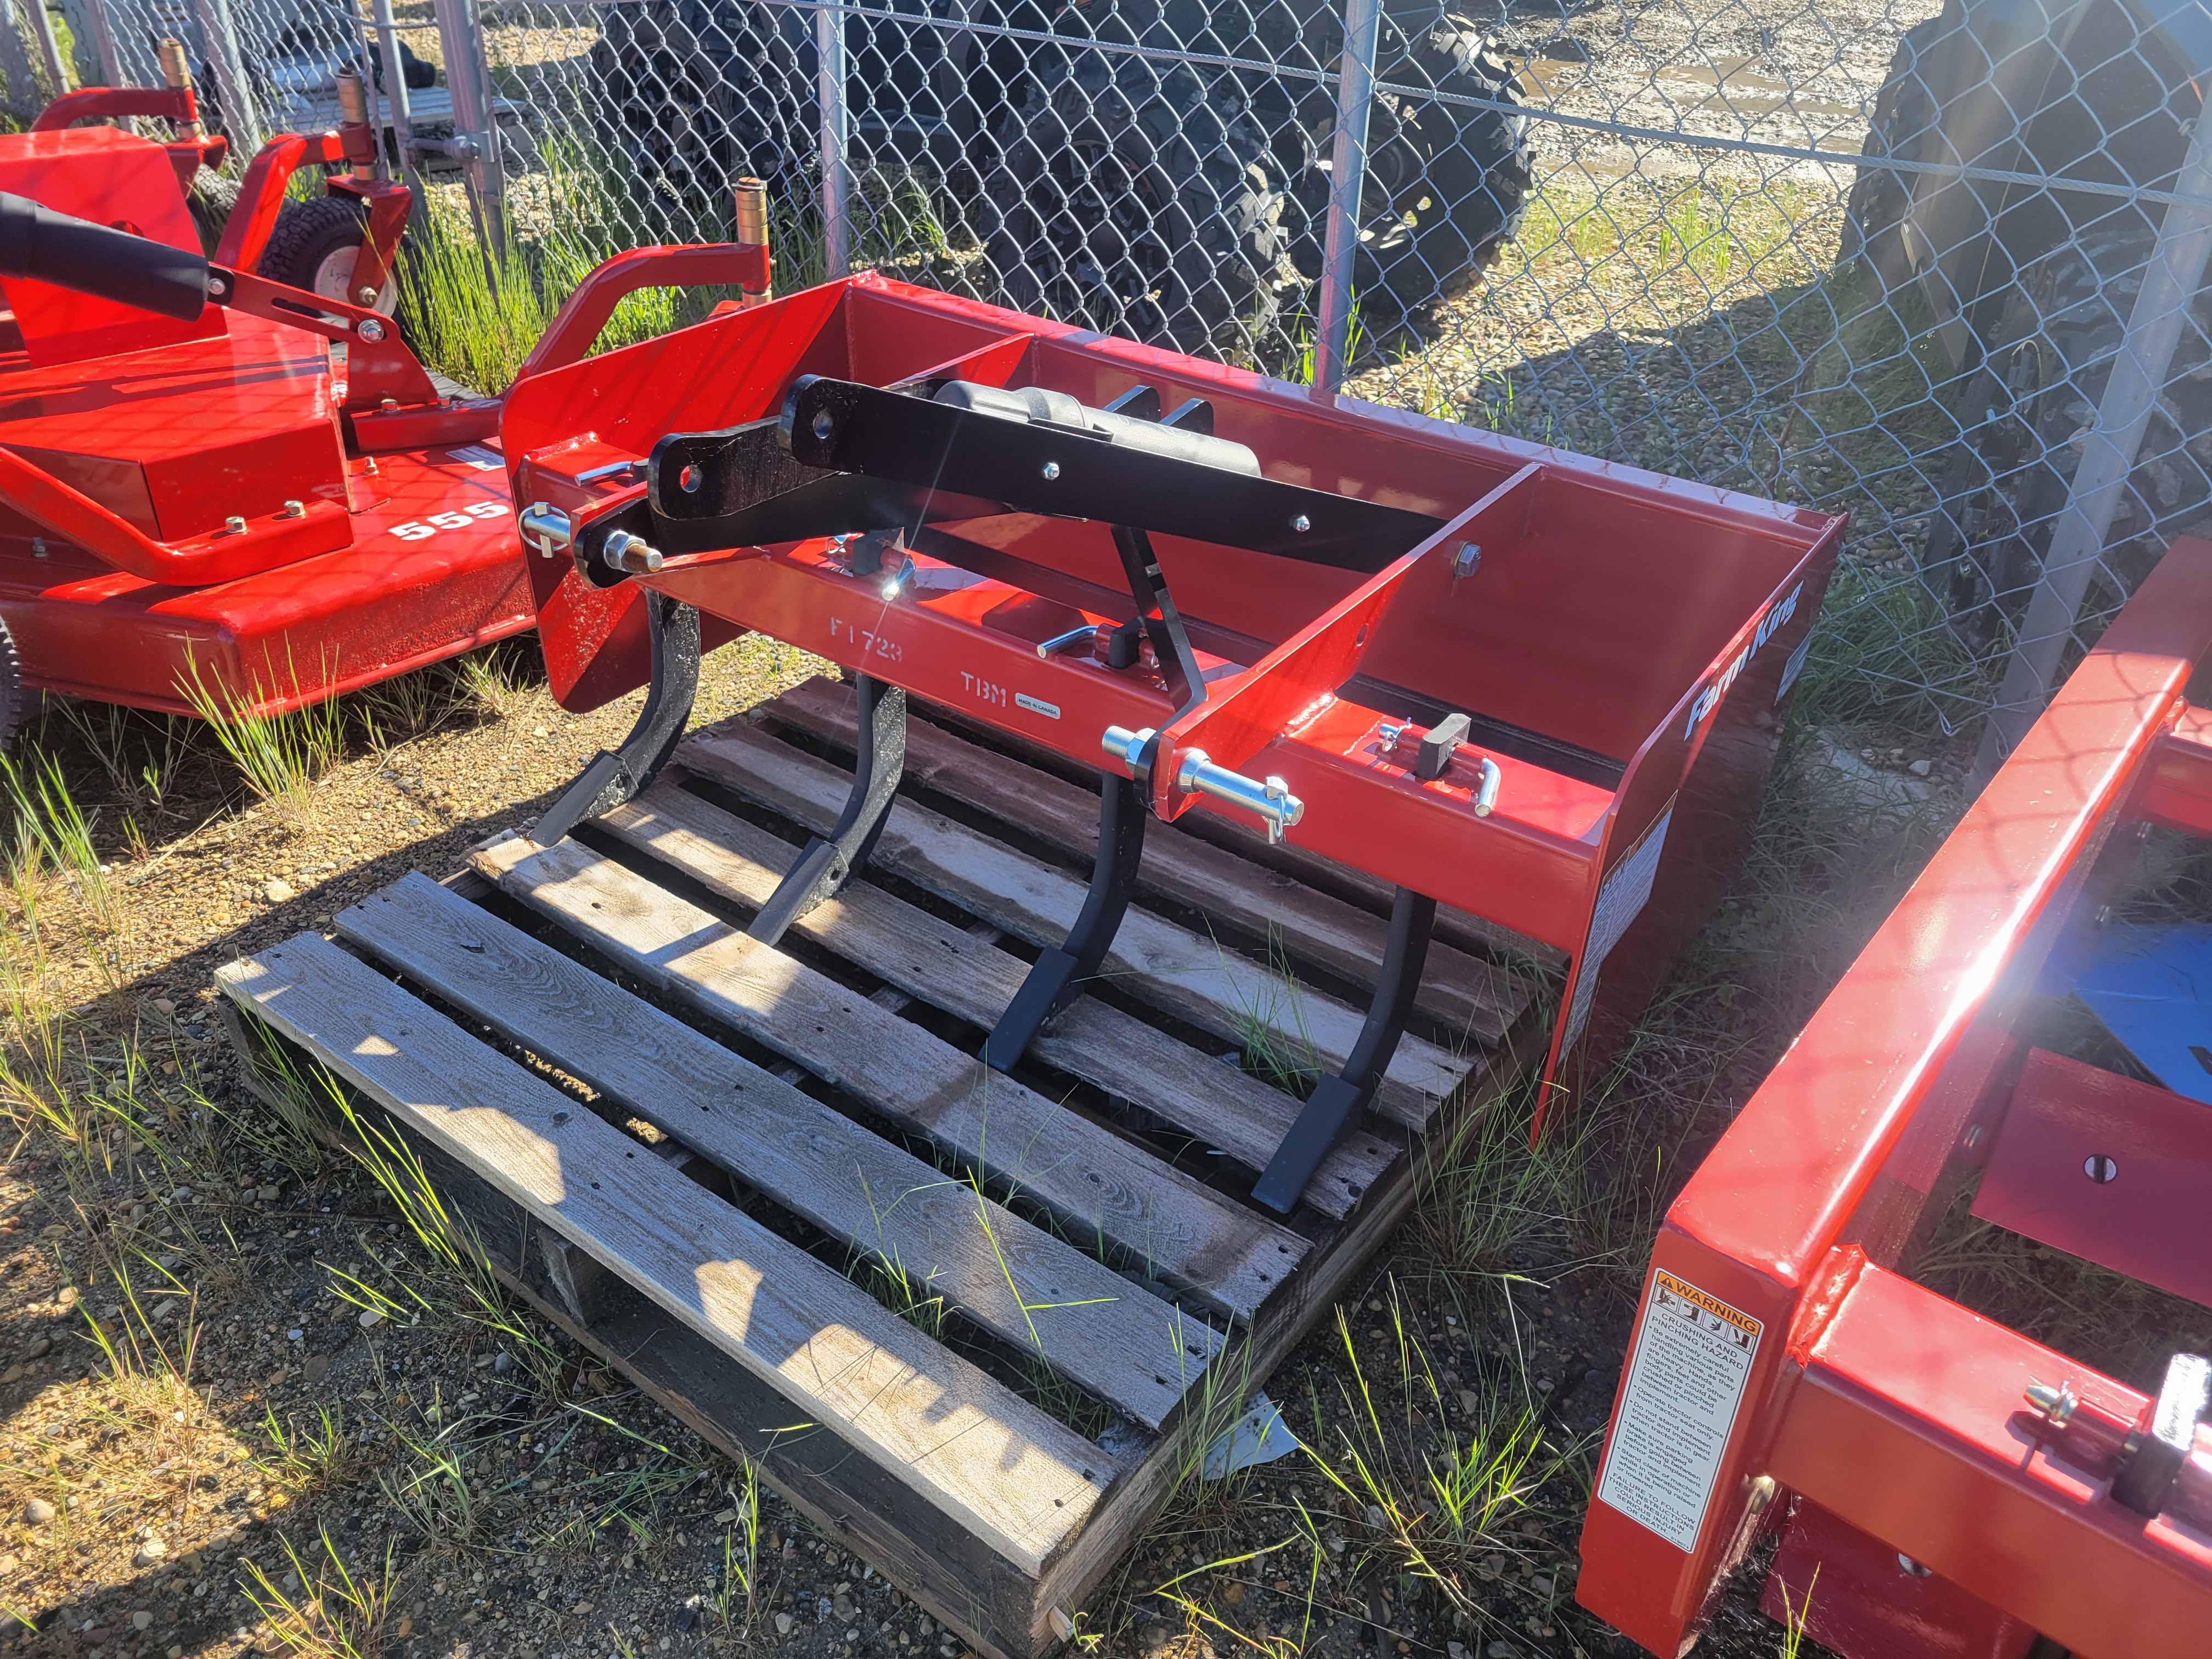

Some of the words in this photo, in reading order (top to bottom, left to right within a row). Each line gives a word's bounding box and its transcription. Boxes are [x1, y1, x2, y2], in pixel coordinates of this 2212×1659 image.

[388, 501, 510, 540] 555
[1684, 645, 1750, 741] Farm
[1749, 580, 1804, 661] King
[1019, 698, 1031, 706] MADE
[1038, 706, 1057, 715] CANADA
[1677, 1282, 1757, 1333] WARNING
[1651, 1315, 1699, 1346] PINCHING
[1701, 1342, 1743, 1370] HAZARD
[1651, 1333, 1684, 1356] handling
[1685, 1352, 1713, 1372] various
[1714, 1368, 1735, 1383] parts
[1653, 1327, 1663, 1337] Be
[1664, 1335, 1702, 1358] extremely
[1702, 1356, 1730, 1373] careful
[1661, 1313, 1714, 1345] CRUSHING
[1714, 1343, 1737, 1358] AND
[1643, 1365, 1673, 1385] crushed
[1683, 1388, 1714, 1408] pinched
[1644, 1358, 1664, 1373] body
[1664, 1370, 1684, 1384] parts
[1685, 1383, 1707, 1397] could
[1707, 1393, 1718, 1403] be
[1646, 1352, 1673, 1372] fingers,
[1675, 1368, 1690, 1381] feet
[1690, 1378, 1706, 1389] and
[1706, 1387, 1728, 1401] other
[1647, 1347, 1660, 1357] are
[1688, 1368, 1715, 1388] Hands,
[1658, 1345, 1671, 1355] the
[1672, 1353, 1706, 1376] machine,
[1707, 1373, 1717, 1381] as
[1718, 1378, 1736, 1391] they
[1636, 1392, 1652, 1406] from
[1654, 1403, 1679, 1420] tractor
[1679, 1418, 1696, 1430] seat
[1637, 1386, 1666, 1406] Operate
[1667, 1403, 1692, 1420] tractor
[1693, 1419, 1724, 1439] controls
[1641, 1370, 1672, 1392] between
[1673, 1389, 1699, 1406] tractor
[1699, 1404, 1714, 1416] and
[1626, 1427, 1646, 1443] brake
[1655, 1446, 1688, 1466] engaged
[1628, 1421, 1647, 1436] Make
[1647, 1434, 1664, 1447] sure
[1665, 1444, 1694, 1464] parking
[1630, 1413, 1650, 1428] when
[1651, 1425, 1676, 1442] tractor
[1684, 1444, 1691, 1452] in
[1632, 1407, 1656, 1424] tractor
[1656, 1422, 1671, 1433] and
[1672, 1430, 1711, 1456] implement
[1633, 1401, 1644, 1410] Do
[1645, 1408, 1658, 1419] not
[1658, 1416, 1680, 1431] stand
[1680, 1427, 1712, 1450] between
[1620, 1453, 1638, 1468] while
[1639, 1464, 1646, 1472] in
[1647, 1471, 1681, 1493] operation
[1621, 1448, 1642, 1463] Stand
[1643, 1462, 1661, 1474] clear
[1670, 1477, 1701, 1498] machine
[1623, 1439, 1647, 1456] tractor
[1647, 1454, 1662, 1465] and
[1624, 1433, 1647, 1450] before
[1648, 1448, 1669, 1464] going
[1671, 1460, 1701, 1482] between
[1608, 1475, 1634, 1495] THESE
[1635, 1492, 1695, 1531] INSTRUCTIONS
[1612, 1472, 1646, 1496] FAILURE
[1647, 1493, 1659, 1503] TO
[1660, 1500, 1696, 1525] FOLLOW
[1618, 1459, 1637, 1474] when
[1652, 1479, 1672, 1496] being
[1673, 1492, 1696, 1509] raised
[1614, 1486, 1642, 1505] COULD
[1644, 1503, 1676, 1525] RESULT
[1676, 1523, 1685, 1532] IN
[1616, 1493, 1651, 1517] SERIOUS
[1652, 1515, 1683, 1536] INJURY
[1626, 1506, 1638, 1516] OR
